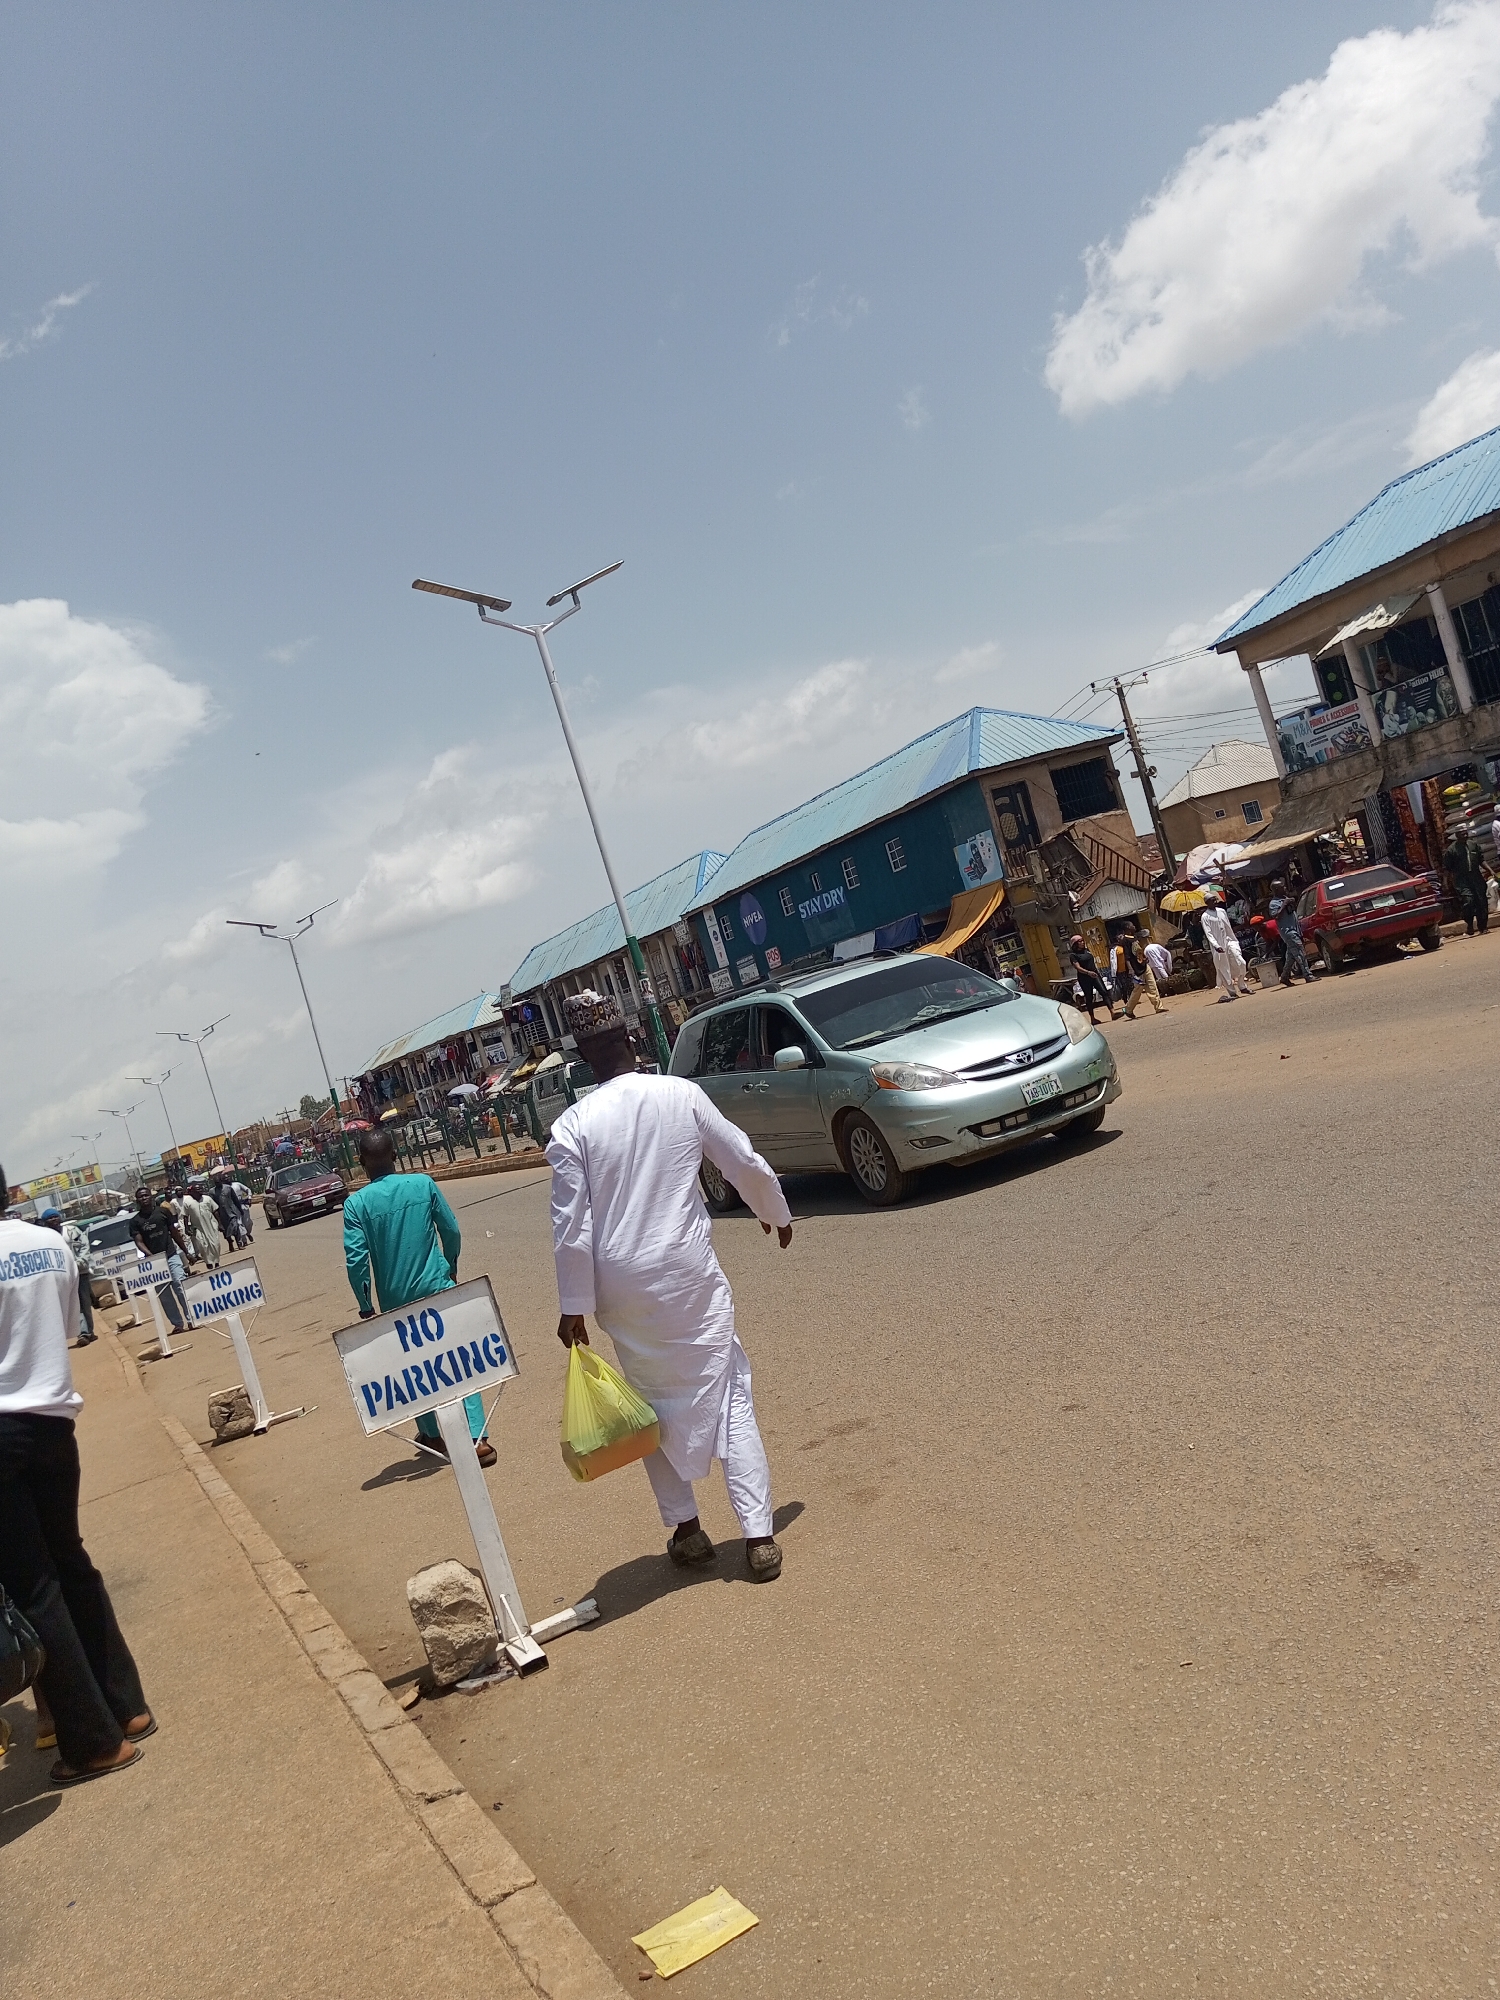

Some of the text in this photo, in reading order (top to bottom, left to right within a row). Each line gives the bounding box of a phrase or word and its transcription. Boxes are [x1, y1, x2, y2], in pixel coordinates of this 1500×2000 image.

[1293, 720, 1312, 739] M&A
[799, 886, 845, 919] STAY DRY
[743, 910, 764, 928] NIVEA
[766, 948, 780, 963] POS
[115, 1254, 126, 1263] NO
[137, 1261, 153, 1274] NO
[126, 1270, 170, 1290] PARKING
[208, 1271, 232, 1291] NO
[192, 1283, 262, 1319] PARKING
[394, 1307, 445, 1353] NO
[360, 1333, 508, 1418] PARKING
